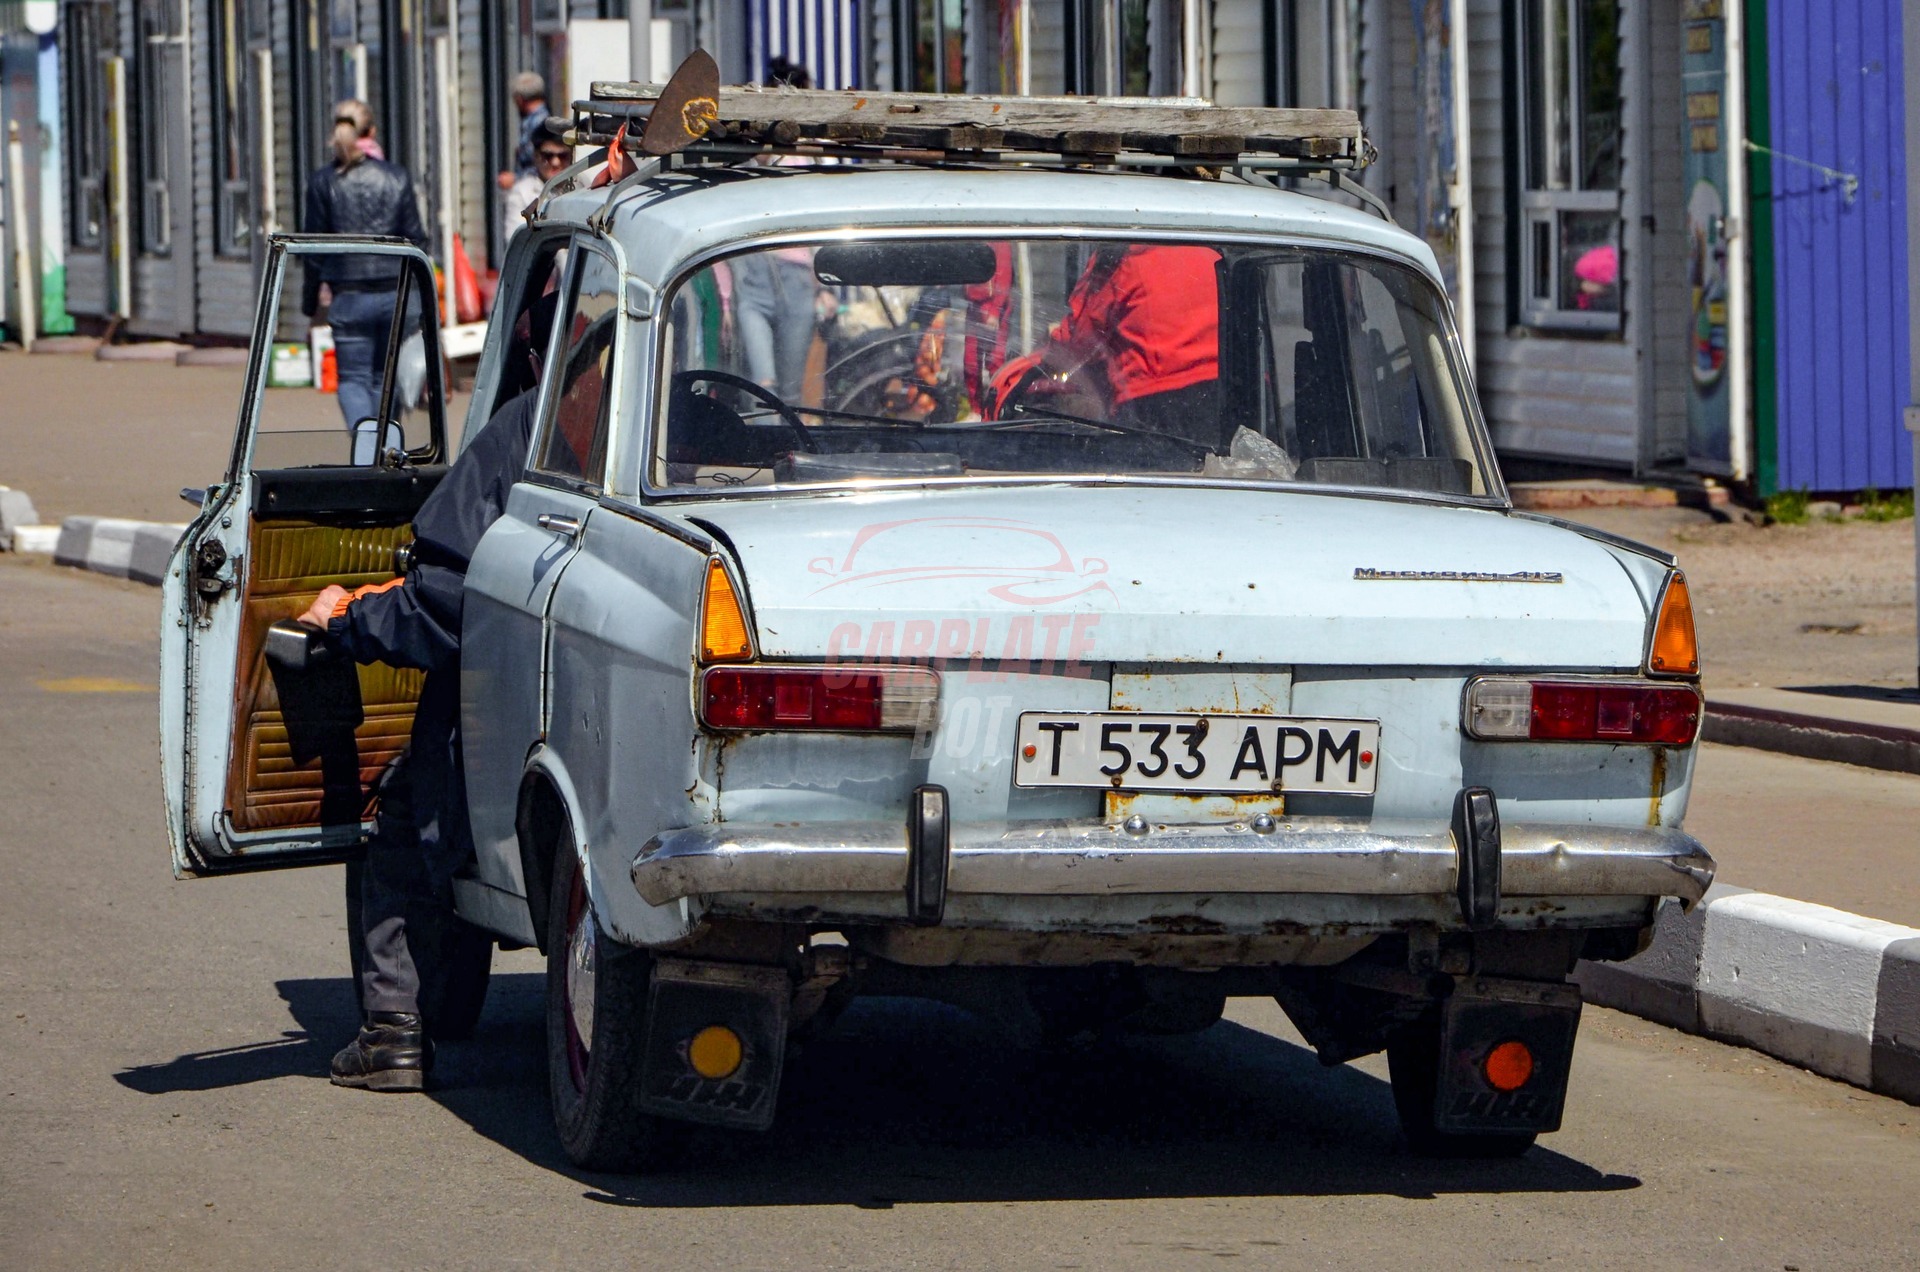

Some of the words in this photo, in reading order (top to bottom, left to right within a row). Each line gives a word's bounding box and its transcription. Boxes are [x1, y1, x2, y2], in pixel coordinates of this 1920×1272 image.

[1038, 722, 1079, 776] Т
[1100, 723, 1208, 779] 533
[1230, 725, 1361, 783] АРМ
